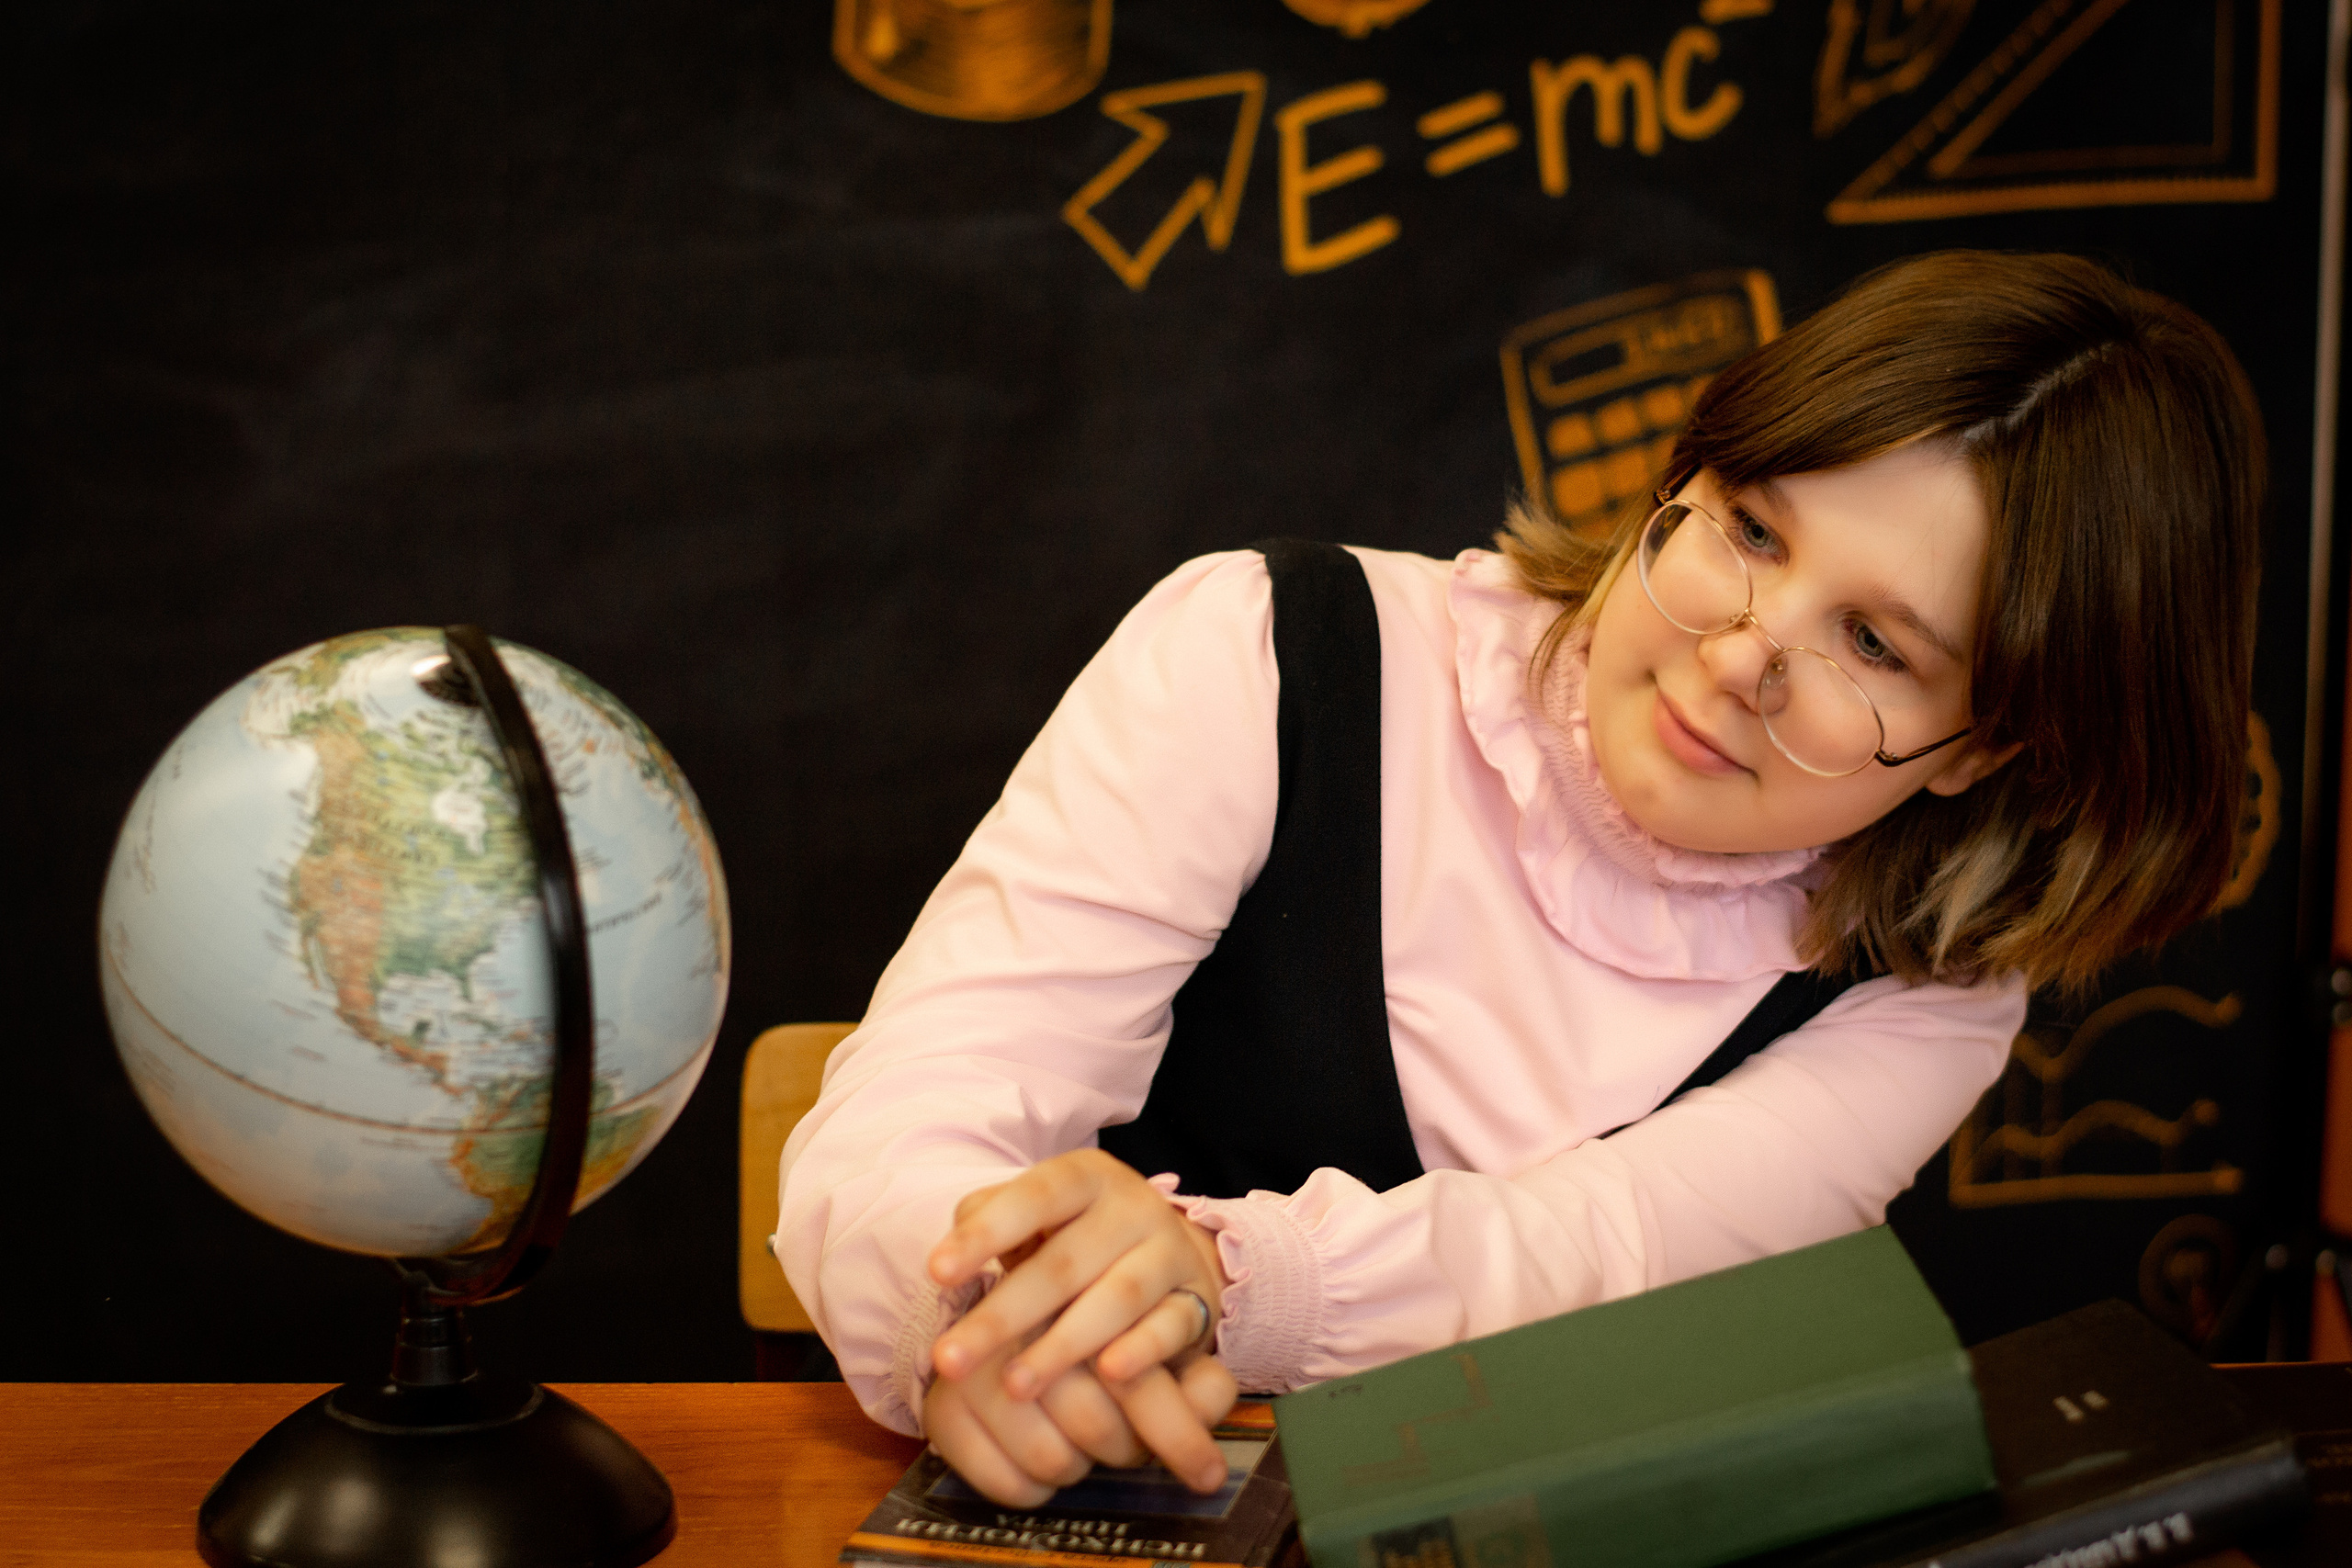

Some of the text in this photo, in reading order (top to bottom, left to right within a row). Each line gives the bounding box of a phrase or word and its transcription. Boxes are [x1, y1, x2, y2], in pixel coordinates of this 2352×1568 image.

[1275, 0, 1769, 274] E = mc
[895, 1517, 1207, 1558] ПСИХОЛОГИЯ
